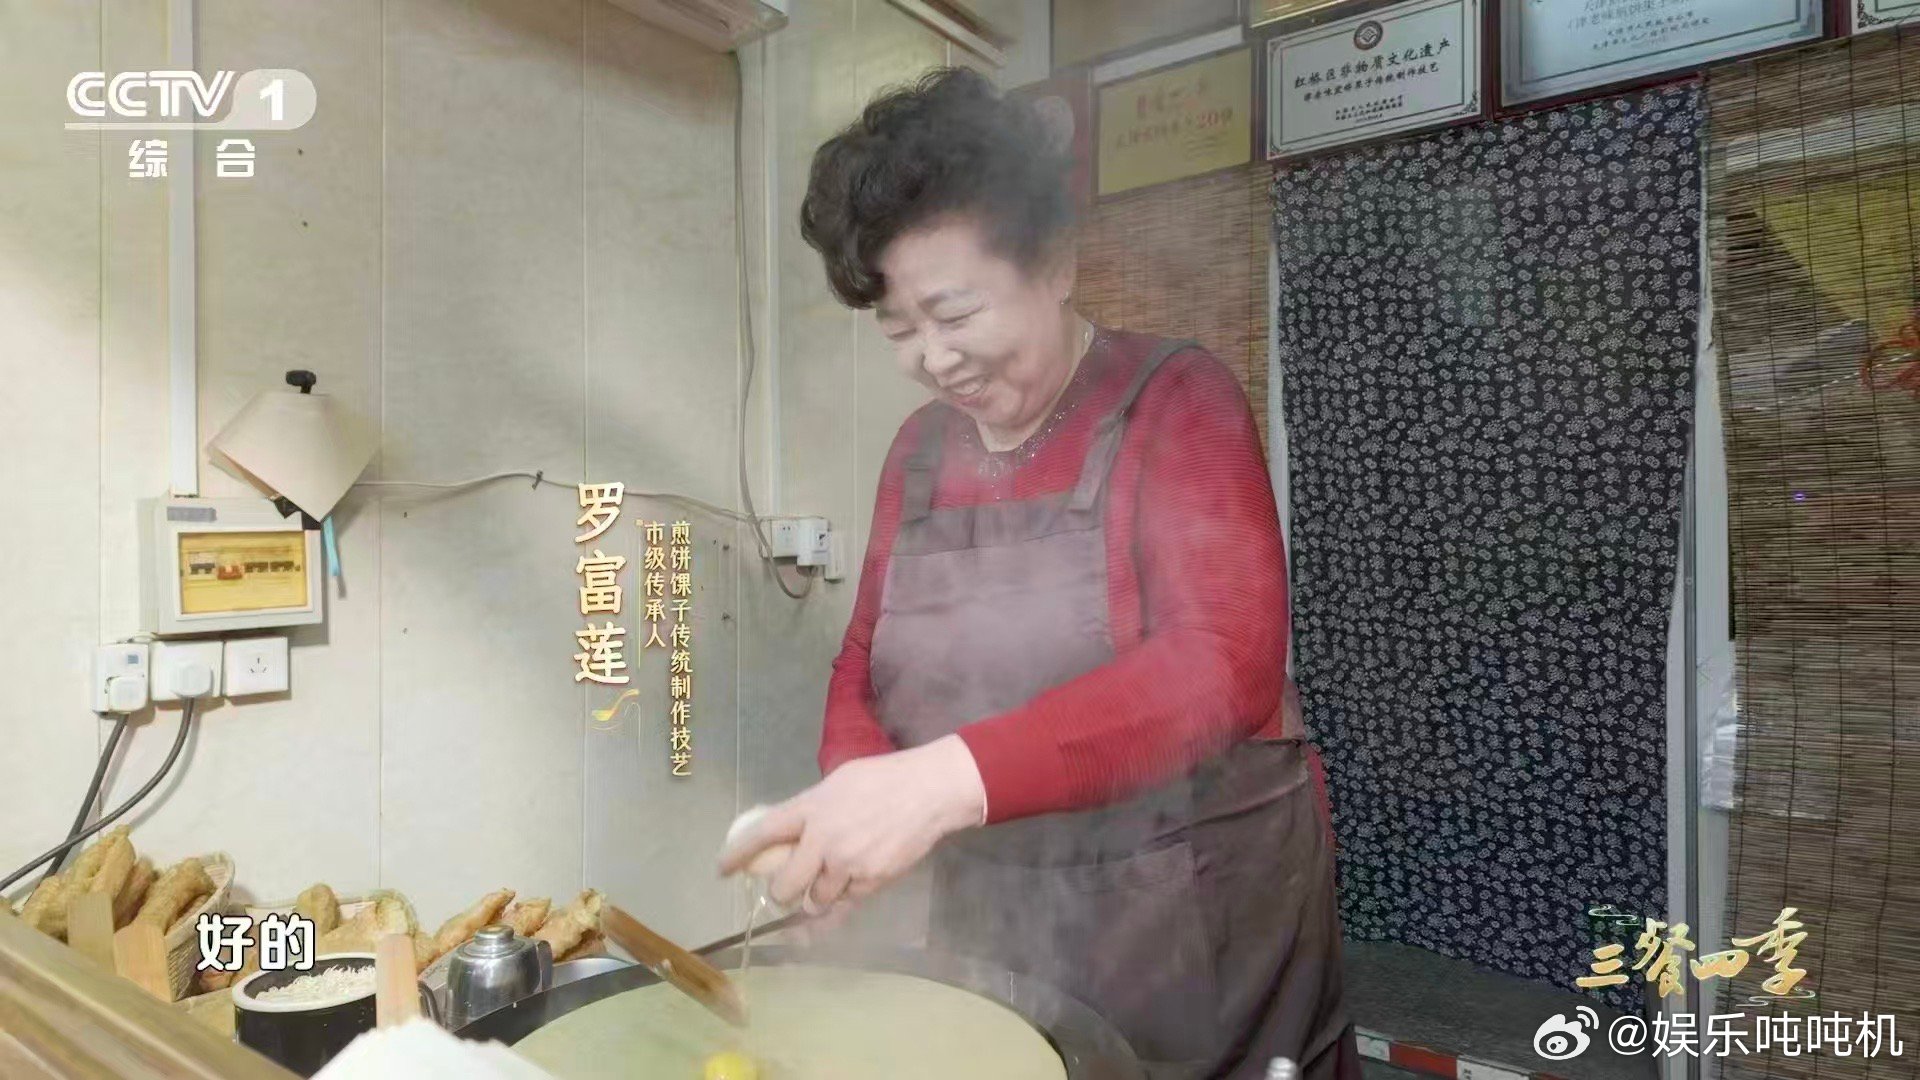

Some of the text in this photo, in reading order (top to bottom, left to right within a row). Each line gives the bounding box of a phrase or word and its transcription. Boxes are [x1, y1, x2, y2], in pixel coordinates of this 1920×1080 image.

[1294, 37, 1451, 89] 红桥区非物质文化遗产
